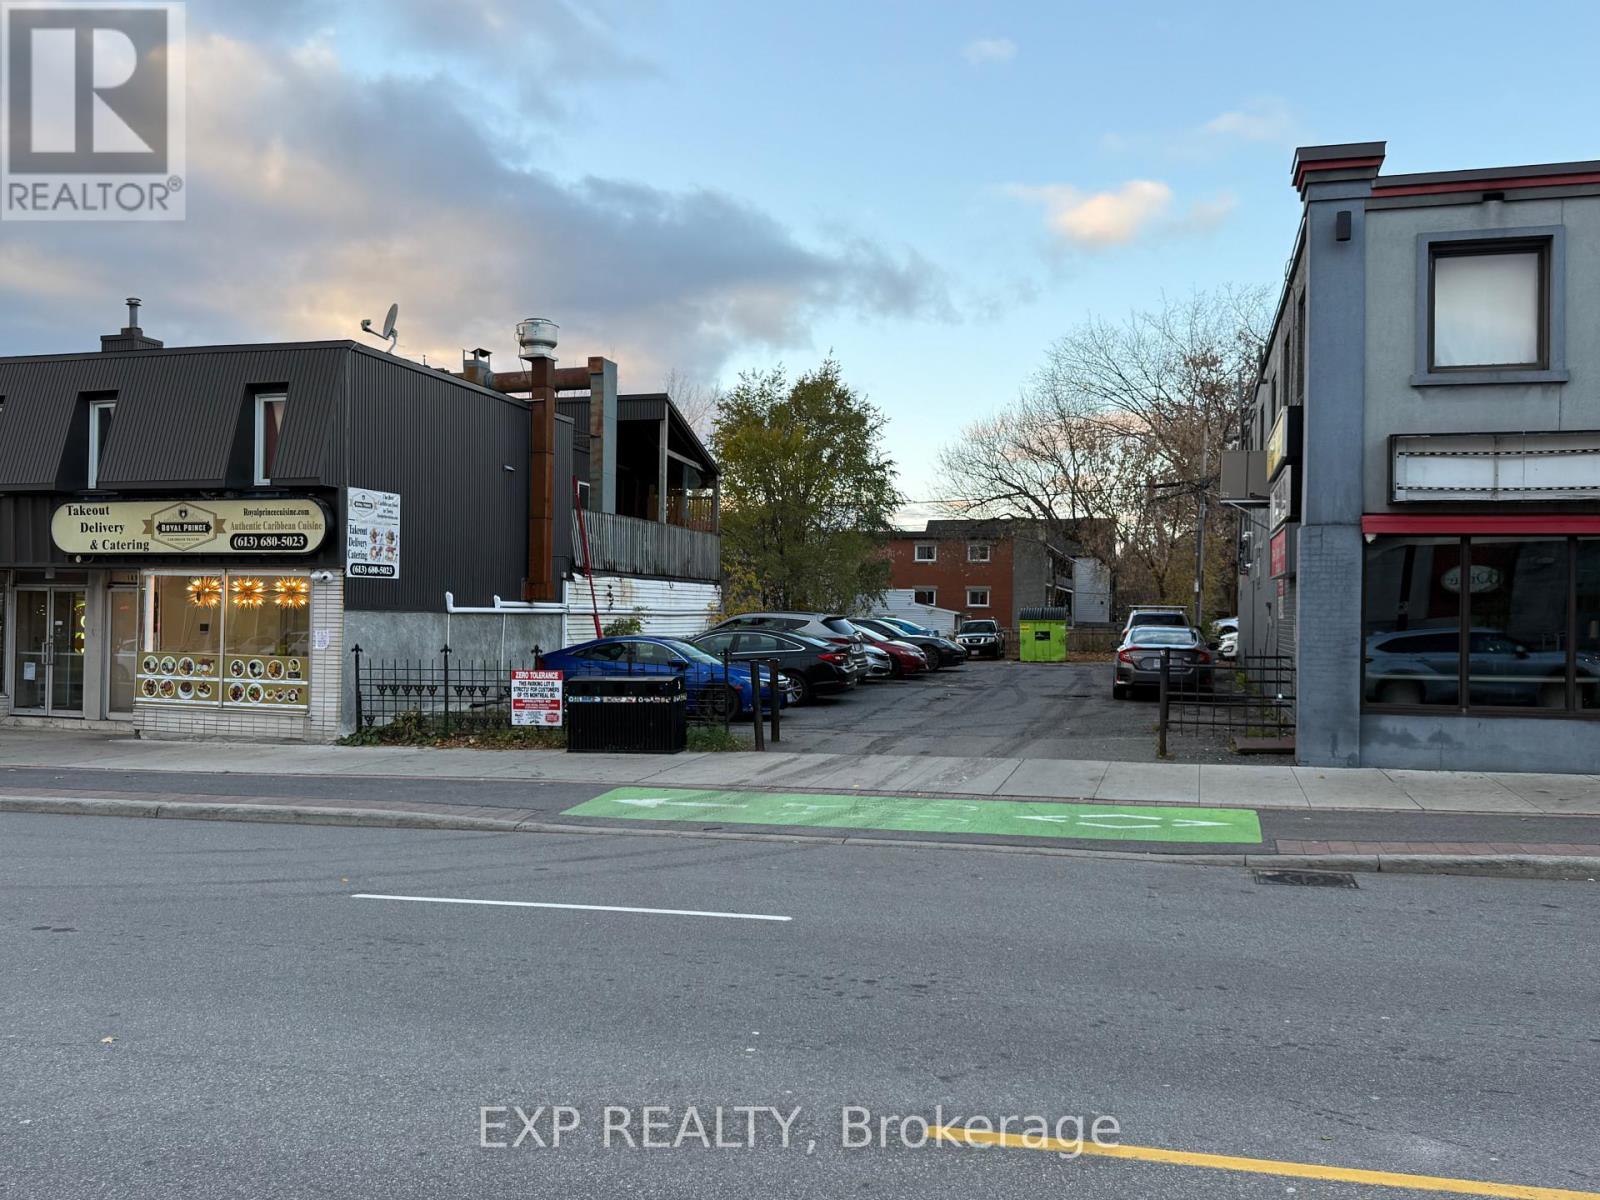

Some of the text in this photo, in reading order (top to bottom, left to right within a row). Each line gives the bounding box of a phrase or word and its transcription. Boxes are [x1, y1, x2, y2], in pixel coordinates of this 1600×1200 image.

[66, 504, 110, 516] Takeout
[80, 522, 125, 535] Delivery
[161, 524, 207, 532] ROYAL PRINCE
[230, 520, 322, 531] Authentic Caribbean Cuisine
[349, 524, 368, 536] Takeout
[90, 540, 150, 552] & Catering
[233, 536, 304, 549] (613) 680-5023
[348, 536, 368, 550] Delivery
[347, 549, 368, 562] Catering
[352, 564, 368, 575] (613)
[515, 671, 559, 679] ZERO TOLERANCE
